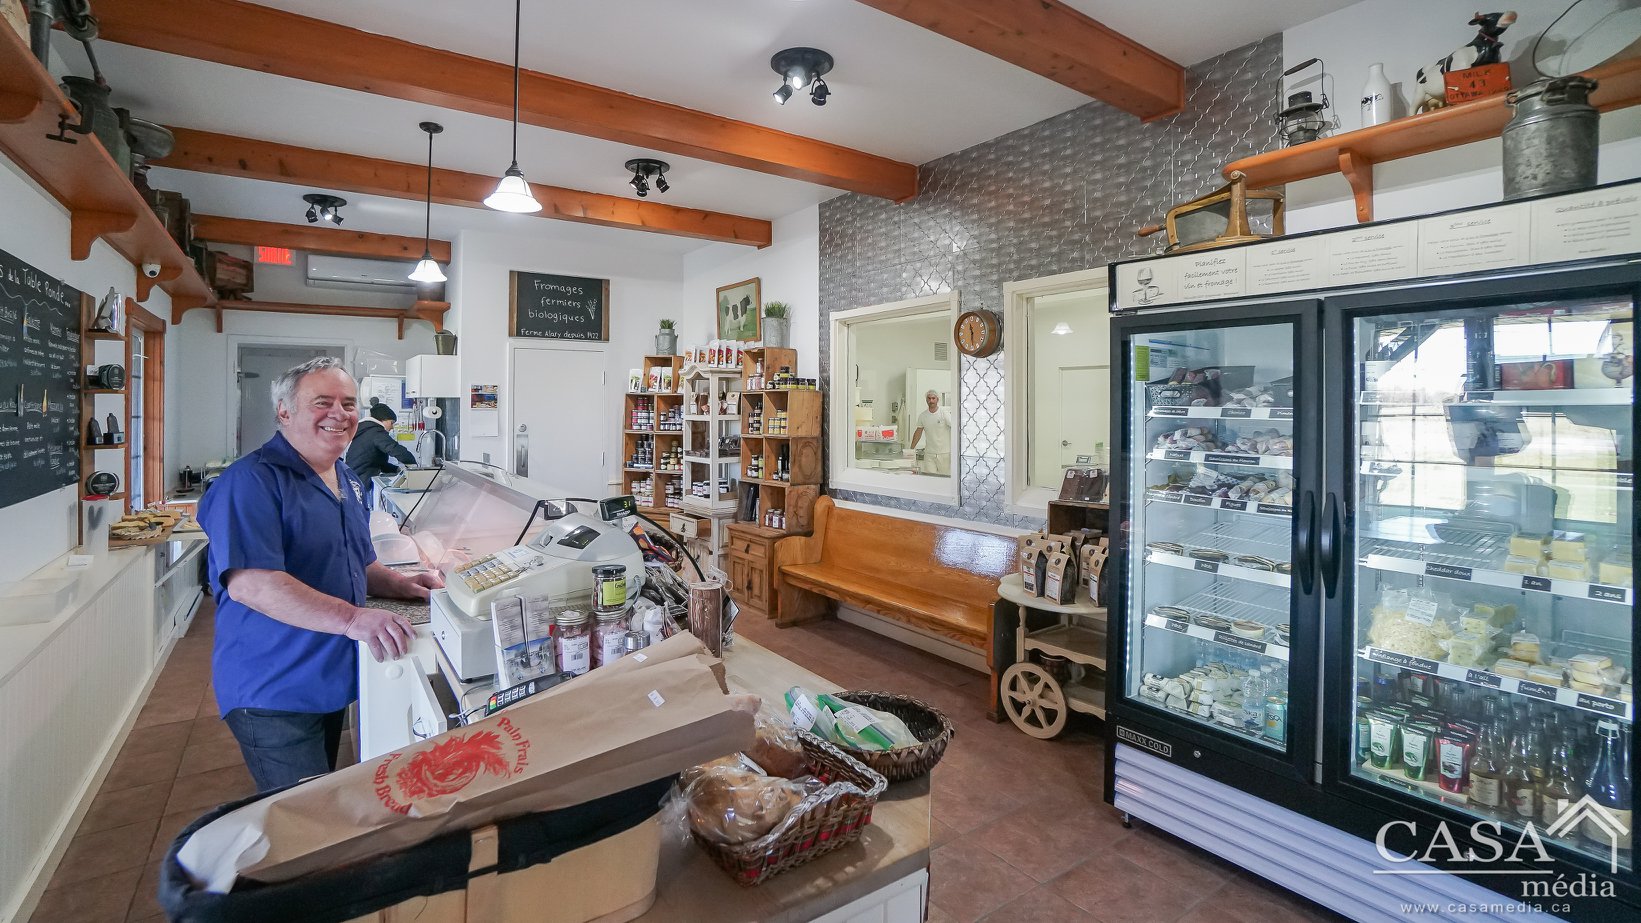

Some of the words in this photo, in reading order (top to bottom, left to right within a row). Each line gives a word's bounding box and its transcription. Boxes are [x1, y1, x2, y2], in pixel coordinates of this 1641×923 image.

[22, 268, 41, 293] Table
[534, 280, 584, 296] Fromages
[541, 296, 581, 309] fermiers
[528, 308, 585, 324] biologiques
[521, 328, 542, 337] Ferme
[544, 330, 561, 339] Alary
[563, 330, 585, 339] depuis
[1591, 700, 1615, 710] porto
[497, 717, 520, 741] Pain
[514, 738, 531, 774] Frais
[1125, 731, 1147, 746] MAXX
[1148, 740, 1169, 753] COLD
[373, 753, 403, 785] Fresh
[375, 784, 413, 816] Bread
